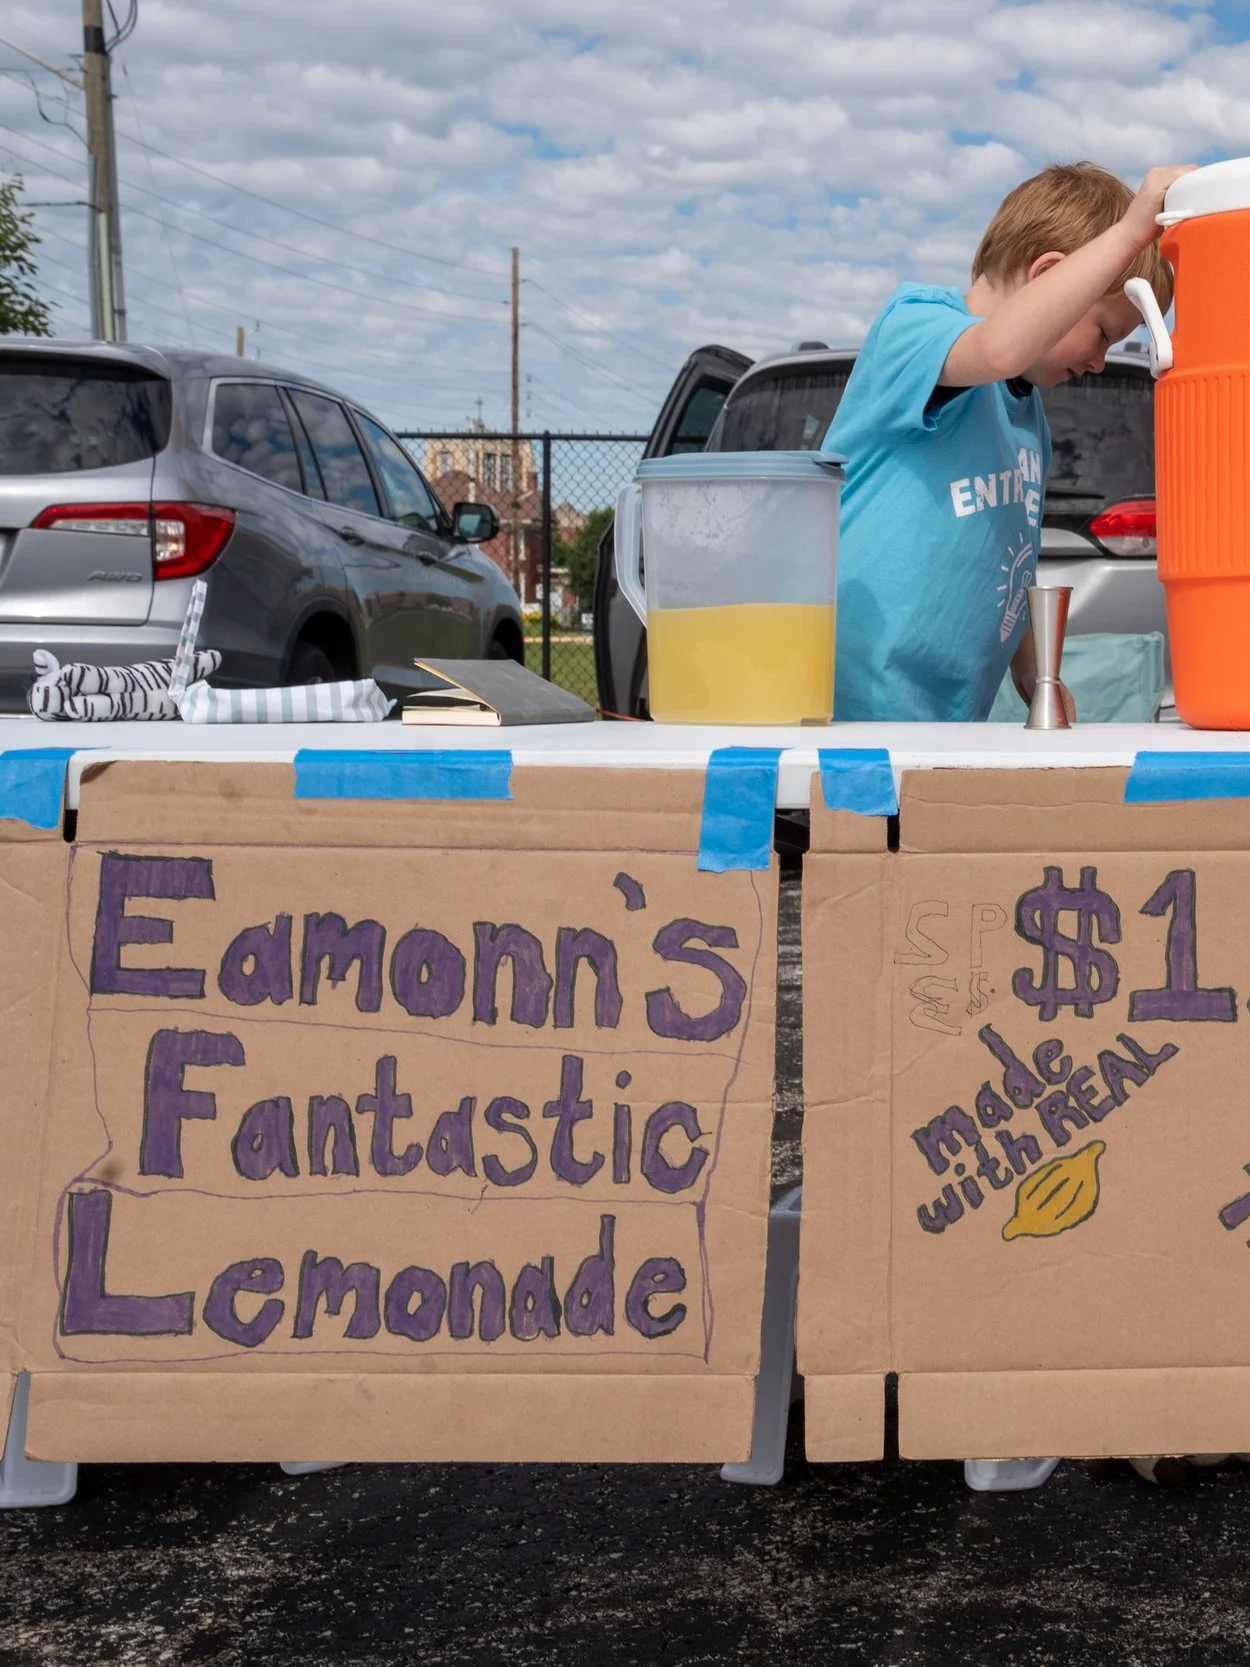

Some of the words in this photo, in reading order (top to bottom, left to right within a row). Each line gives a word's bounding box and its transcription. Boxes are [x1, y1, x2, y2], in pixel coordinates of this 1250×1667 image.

[1018, 447, 1041, 485] AN
[90, 851, 748, 1042] Eamonn's
[138, 1028, 710, 1194] Fantastic
[910, 1024, 1073, 1177] made
[917, 1127, 1043, 1234] with
[1039, 1033, 1180, 1147] REAL
[60, 1188, 688, 1347] Lemonade
